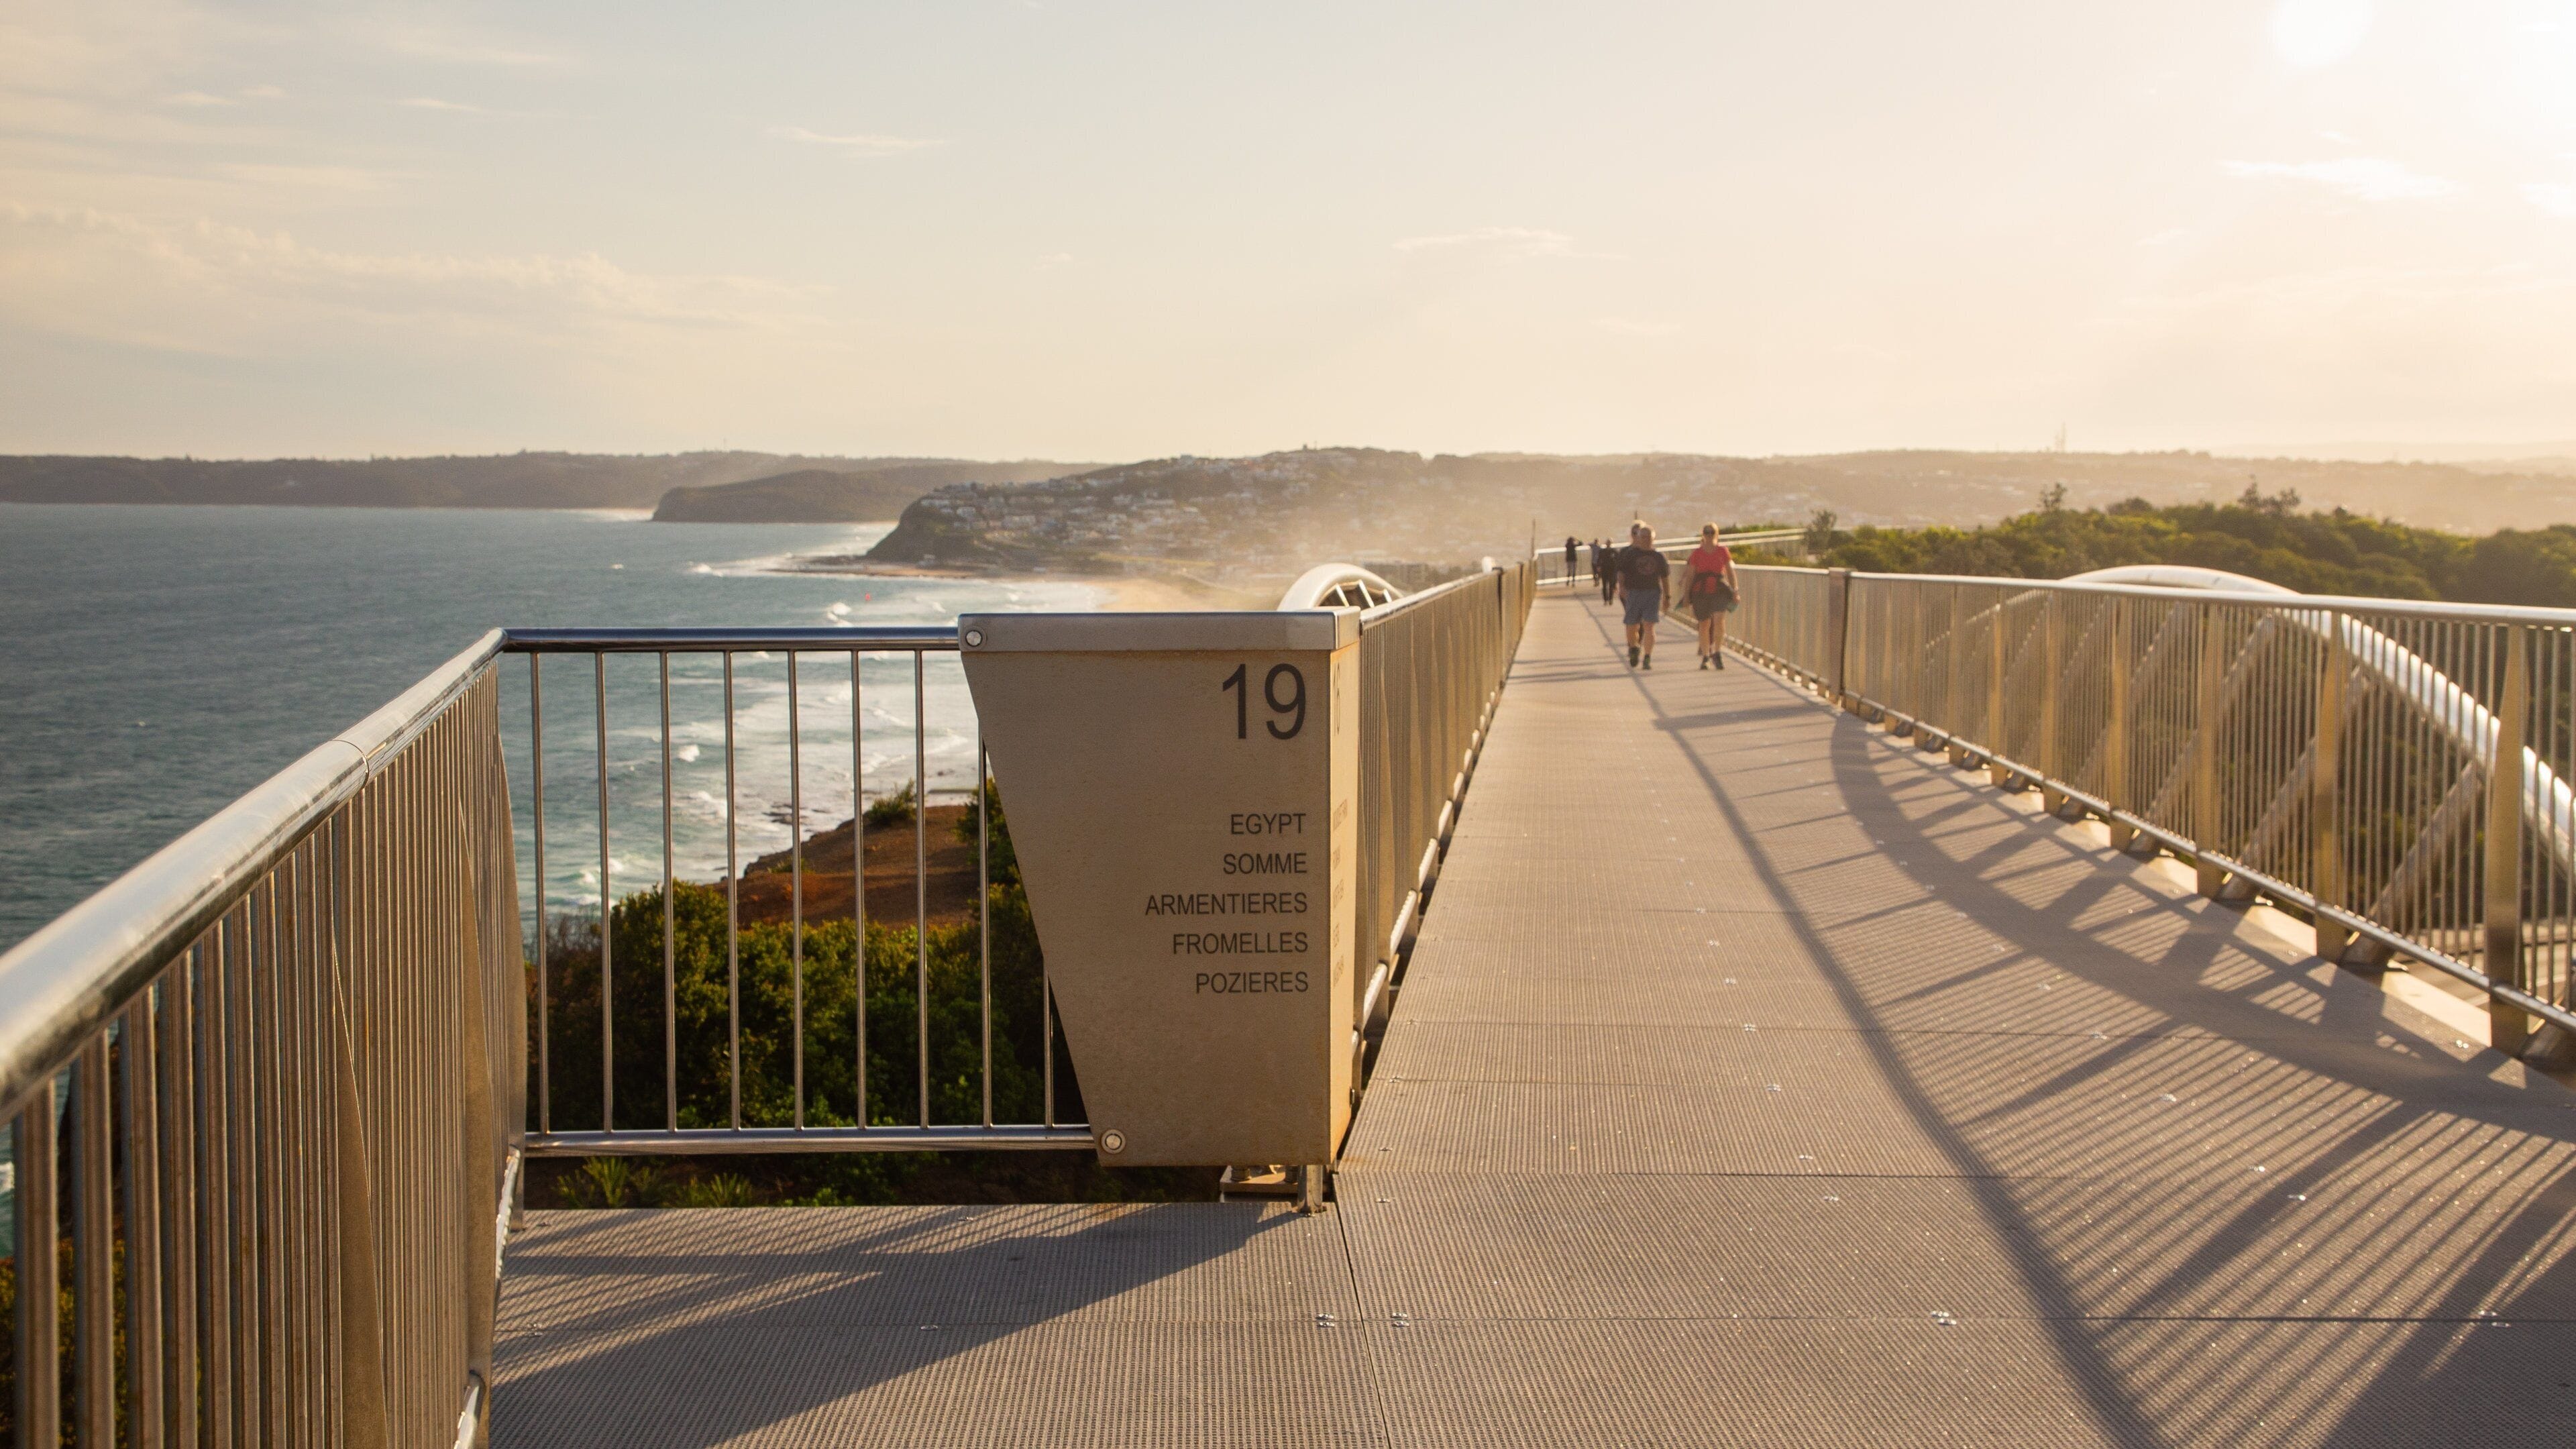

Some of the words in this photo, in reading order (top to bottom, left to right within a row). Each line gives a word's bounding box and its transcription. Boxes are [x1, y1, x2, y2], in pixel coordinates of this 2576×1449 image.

[1222, 663, 1307, 740] 19
[1231, 813, 1307, 835] EGYPT
[1223, 853, 1308, 875] SOMME
[1145, 892, 1308, 916] ARMENTIERES
[1173, 932, 1309, 955] FROMELLES
[1196, 971, 1309, 995] POZIERES
